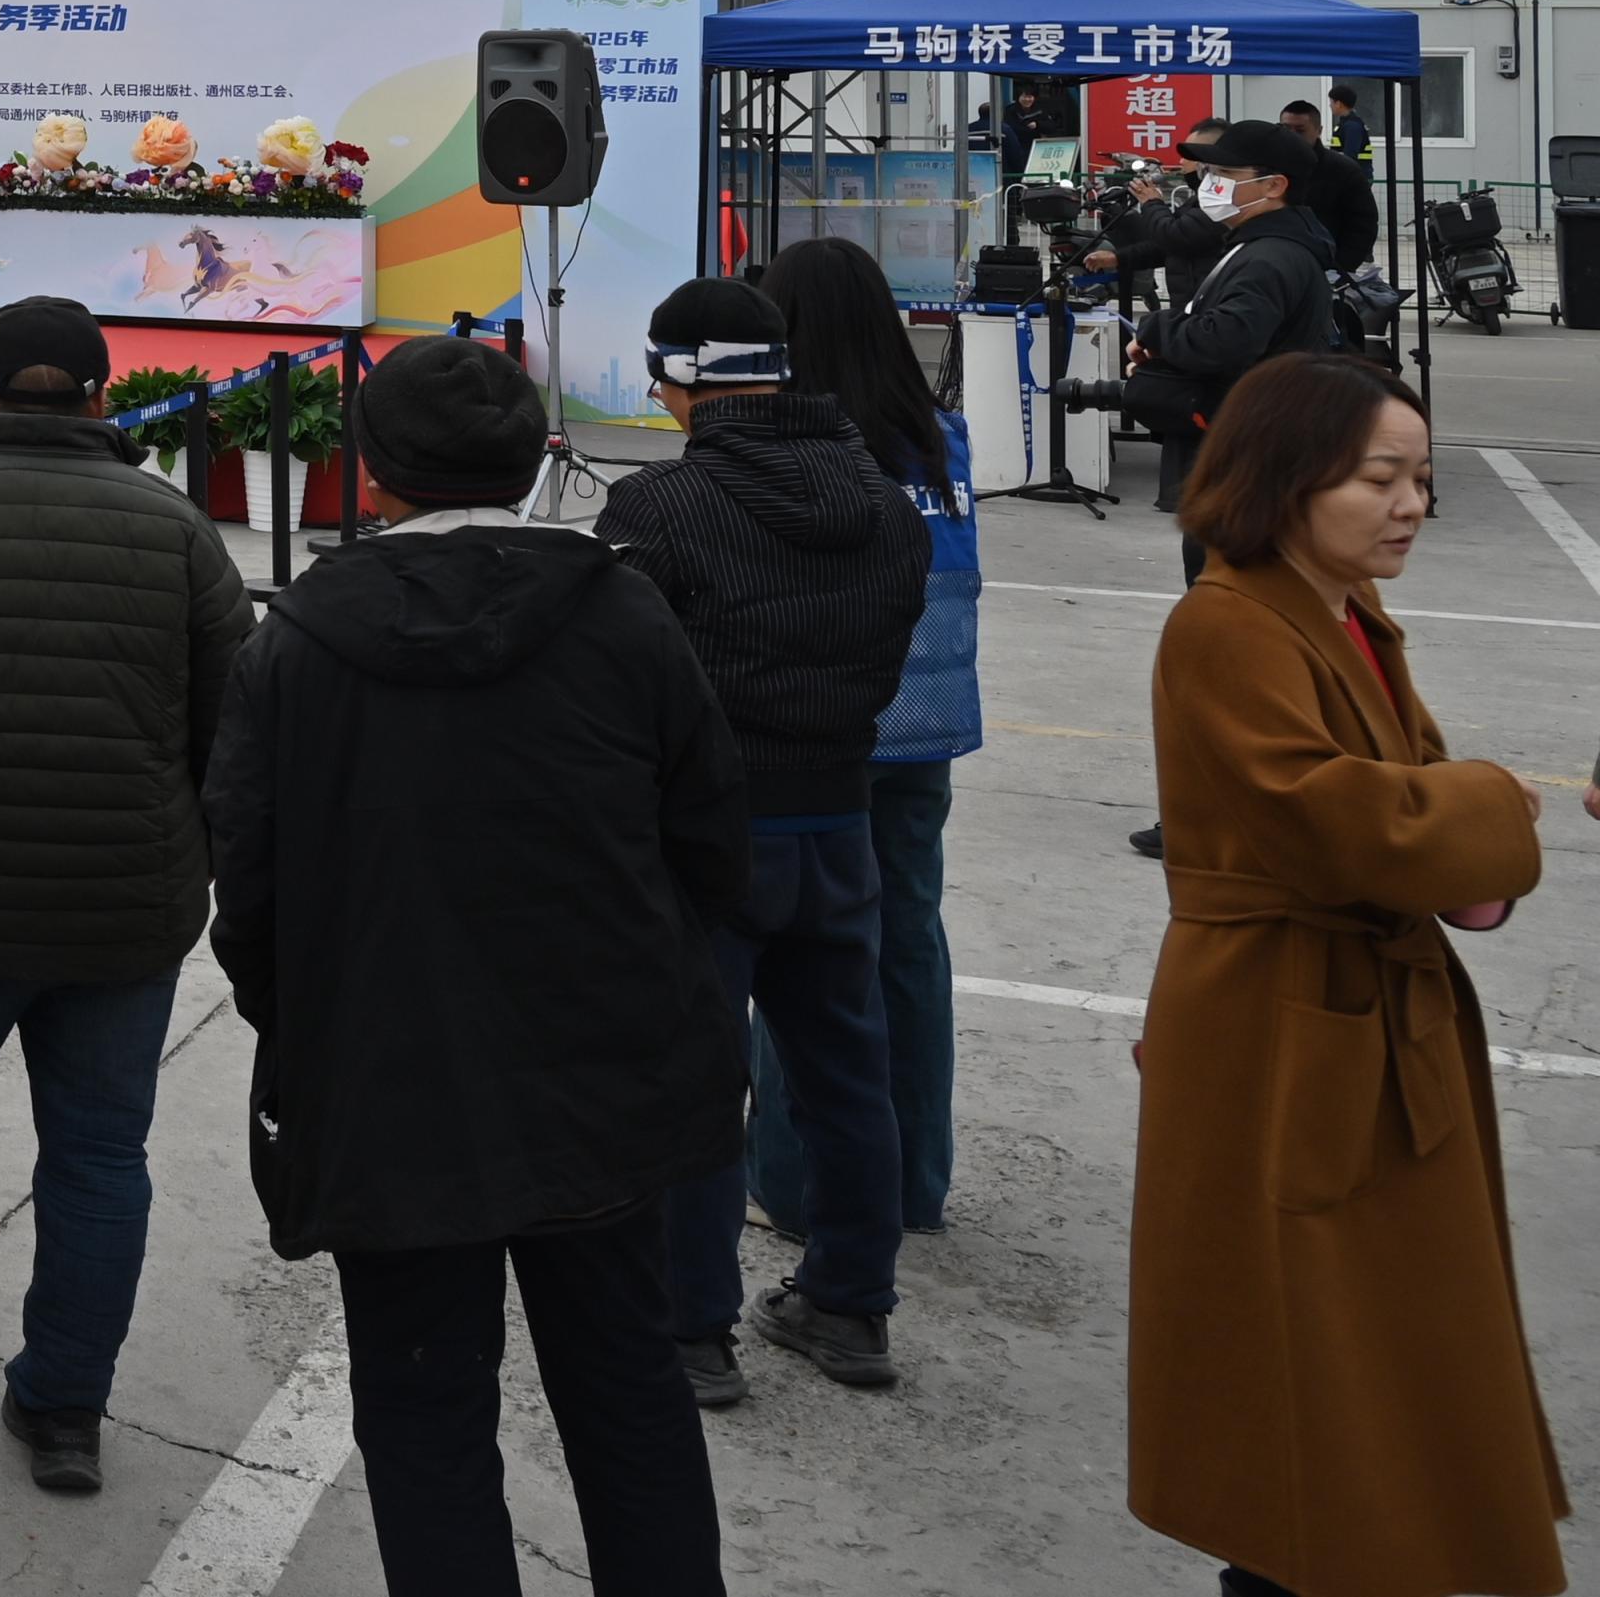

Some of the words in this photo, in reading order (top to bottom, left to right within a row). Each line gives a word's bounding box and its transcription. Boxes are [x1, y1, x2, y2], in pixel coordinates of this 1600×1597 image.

[583, 30, 649, 47] 026年
[863, 23, 1232, 68] 马驹桥零工市场
[595, 57, 679, 76] 零工市场
[910, 301, 985, 312] 马驹桥零工市场
